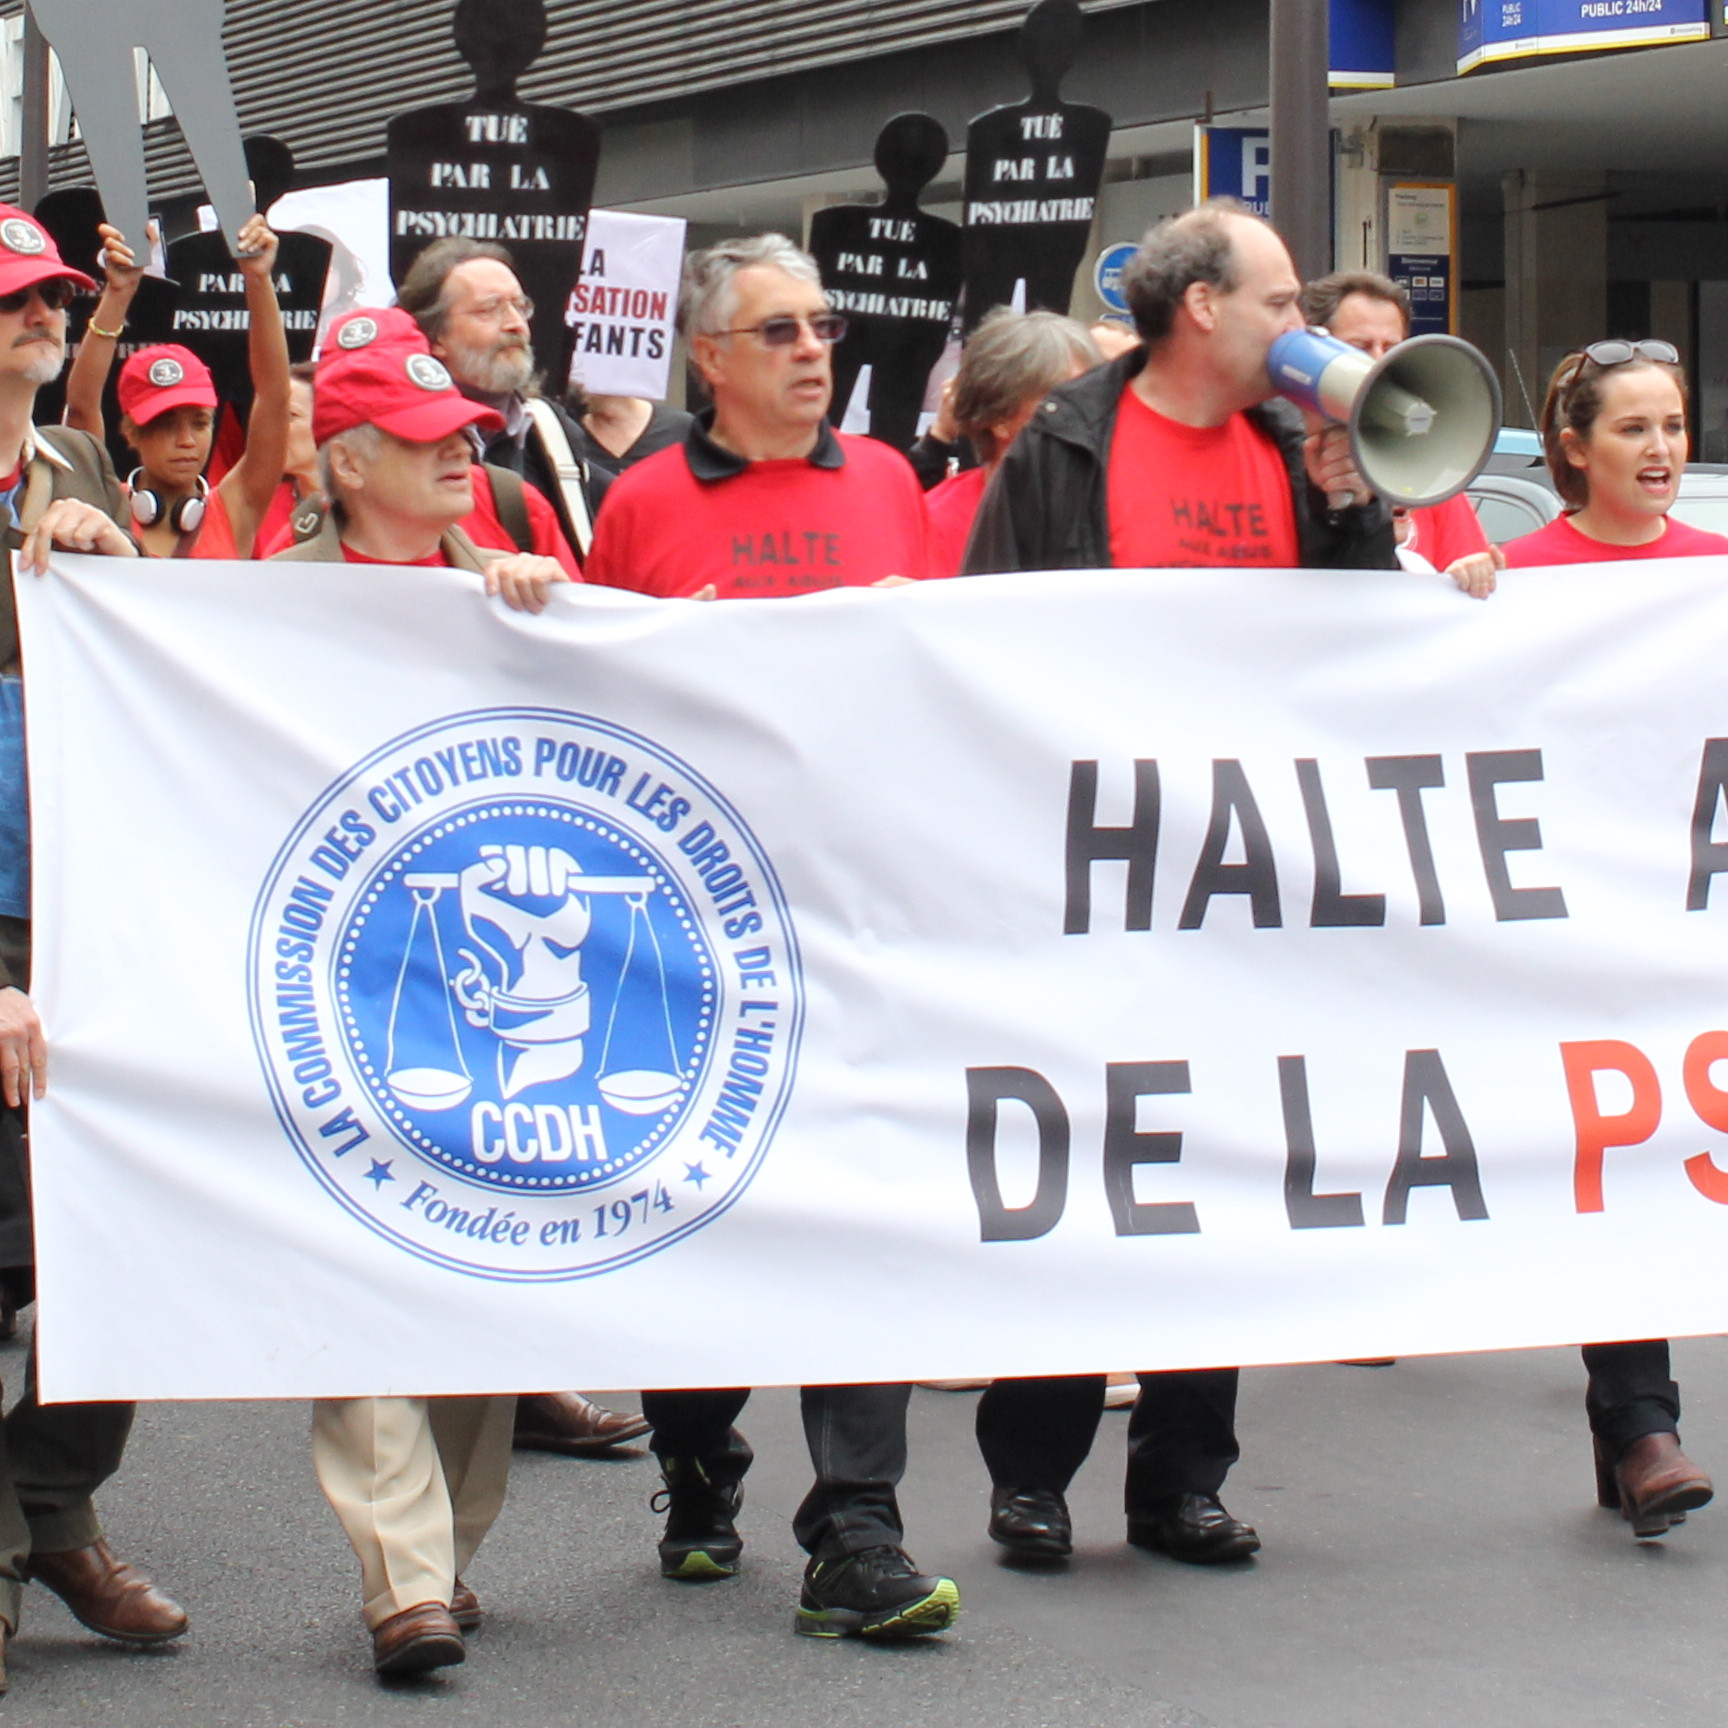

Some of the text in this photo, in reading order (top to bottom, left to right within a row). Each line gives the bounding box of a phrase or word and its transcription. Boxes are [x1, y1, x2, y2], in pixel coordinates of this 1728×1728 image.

[1502, 1, 1522, 15] PUBLIC
[1581, 1, 1623, 19] PUBLIC
[464, 113, 529, 144] TUÉ
[1020, 113, 1064, 140] TUÉ
[429, 162, 551, 190] PAR LA
[992, 155, 1075, 182] PAR LA
[395, 209, 587, 241] PSYCHIATRIE
[967, 197, 1095, 226] PSYCHIATRIE
[868, 218, 916, 242] TUÉ
[579, 248, 606, 277] A
[836, 252, 928, 280] PAR LA
[272, 273, 292, 293] A
[566, 284, 668, 321] SATION
[824, 289, 953, 322] SYCHIATRIE
[172, 309, 319, 331] PSYCHIRIE
[573, 322, 666, 360] FANTS
[1170, 498, 1269, 537] HALTE
[731, 530, 844, 566] HALTE
[1063, 748, 1570, 936] HALTE
[275, 736, 780, 1160] LA COMMISSION DES CITOYENS POUR LES DROITS DE L'HOMME
[471, 1100, 609, 1165] CCDH
[963, 1059, 1203, 1241] DE
[1276, 1048, 1491, 1230] LA
[400, 1179, 676, 1247] Fondée en 1974
